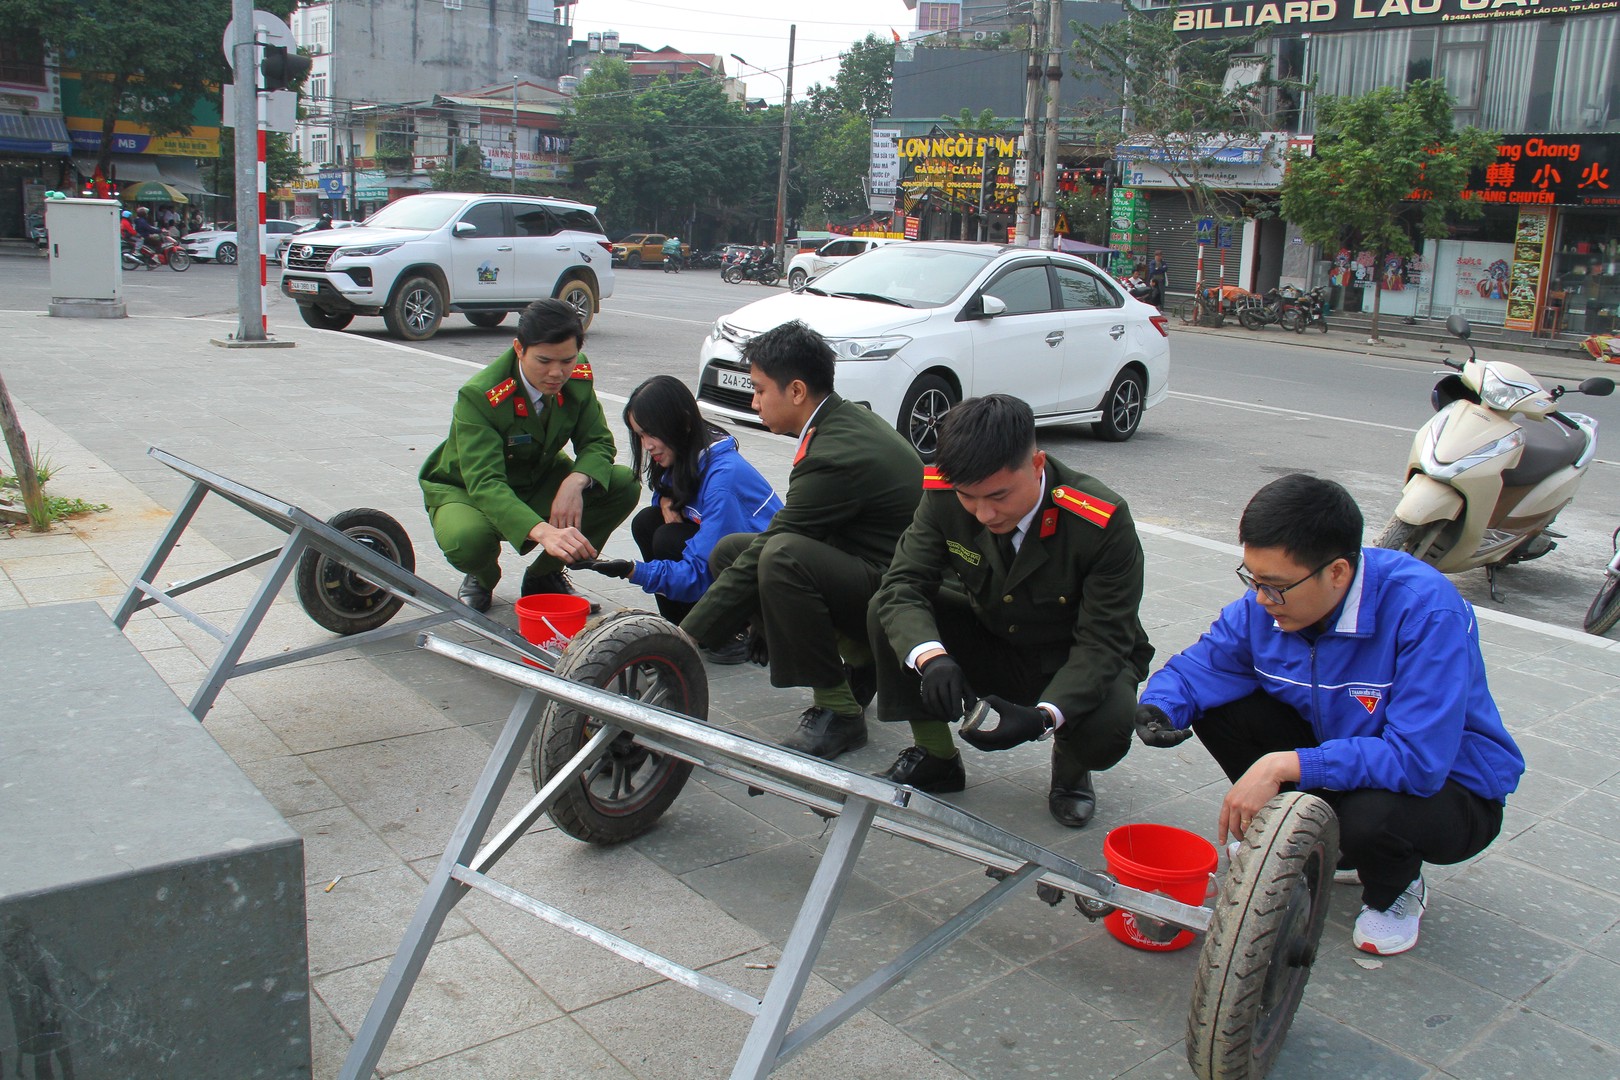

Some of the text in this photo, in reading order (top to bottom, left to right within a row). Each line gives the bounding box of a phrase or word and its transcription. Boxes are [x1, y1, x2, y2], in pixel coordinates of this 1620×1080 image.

[1173, 0, 1336, 31] BILLIARD
[118, 138, 136, 149] MB
[501, 150, 518, 160] PHÒG
[897, 138, 929, 162] LỢN
[932, 134, 972, 158] NGÒI
[1525, 138, 1580, 161] Chang
